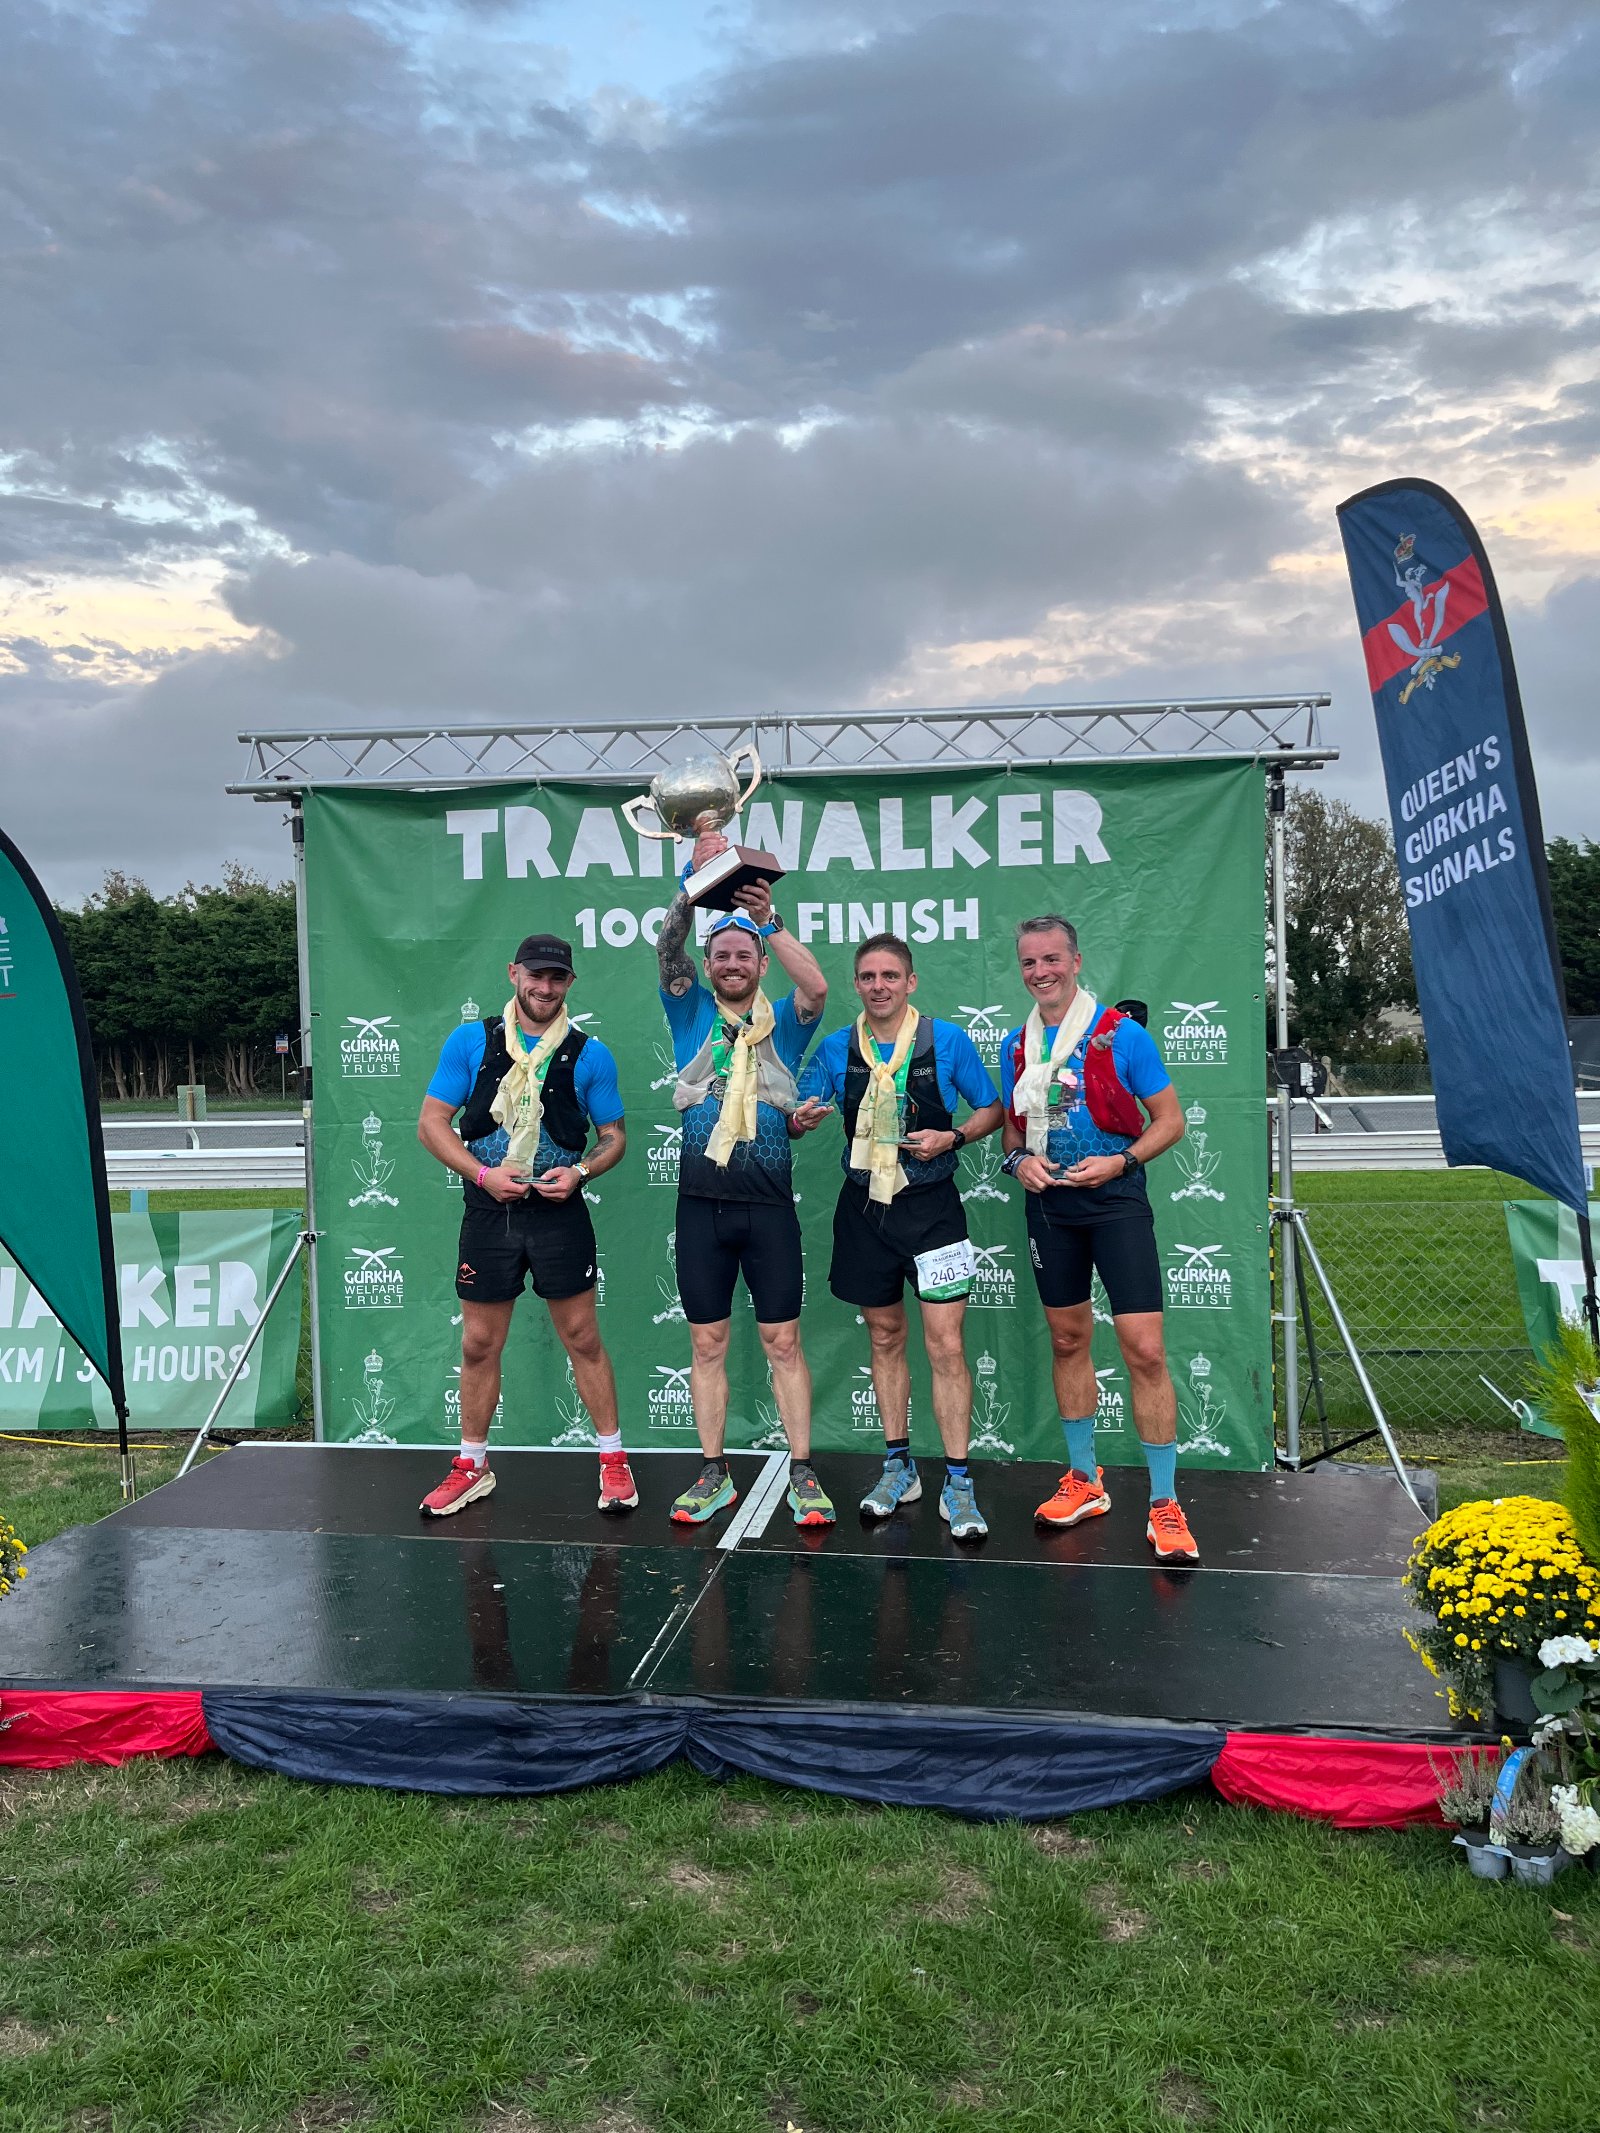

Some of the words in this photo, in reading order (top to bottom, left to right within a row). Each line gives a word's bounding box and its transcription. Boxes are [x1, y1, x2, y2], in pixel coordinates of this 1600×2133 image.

[1401, 735, 1500, 822] QUEEN'S
[1405, 783, 1508, 864] GURKHA
[1405, 826, 1516, 908] SIGNALS
[798, 898, 979, 944] FINISH
[1163, 1025, 1227, 1039] GURKHA
[340, 1039, 400, 1052] GURKHA
[1164, 1040, 1228, 1050] WELFARE
[341, 1053, 400, 1063] WELFARE
[1164, 1051, 1228, 1061] TRUST
[342, 1064, 401, 1073] TRUST
[648, 1162, 680, 1171] WELF
[648, 1173, 679, 1181] TRU
[344, 1270, 404, 1284] GURKHA
[930, 1262, 969, 1286] 240-3
[975, 1268, 1015, 1282] RKHA
[1167, 1268, 1231, 1282] GURKHA
[344, 1285, 404, 1294] WELFARE
[1168, 1283, 1232, 1294] WELFARE
[344, 1295, 404, 1305] TRUST
[969, 1294, 1016, 1304] RUST
[1168, 1294, 1232, 1305] TRUST
[132, 1344, 250, 1381] HOURS
[648, 1389, 693, 1403] GURKH
[648, 1415, 693, 1425] TRUS
